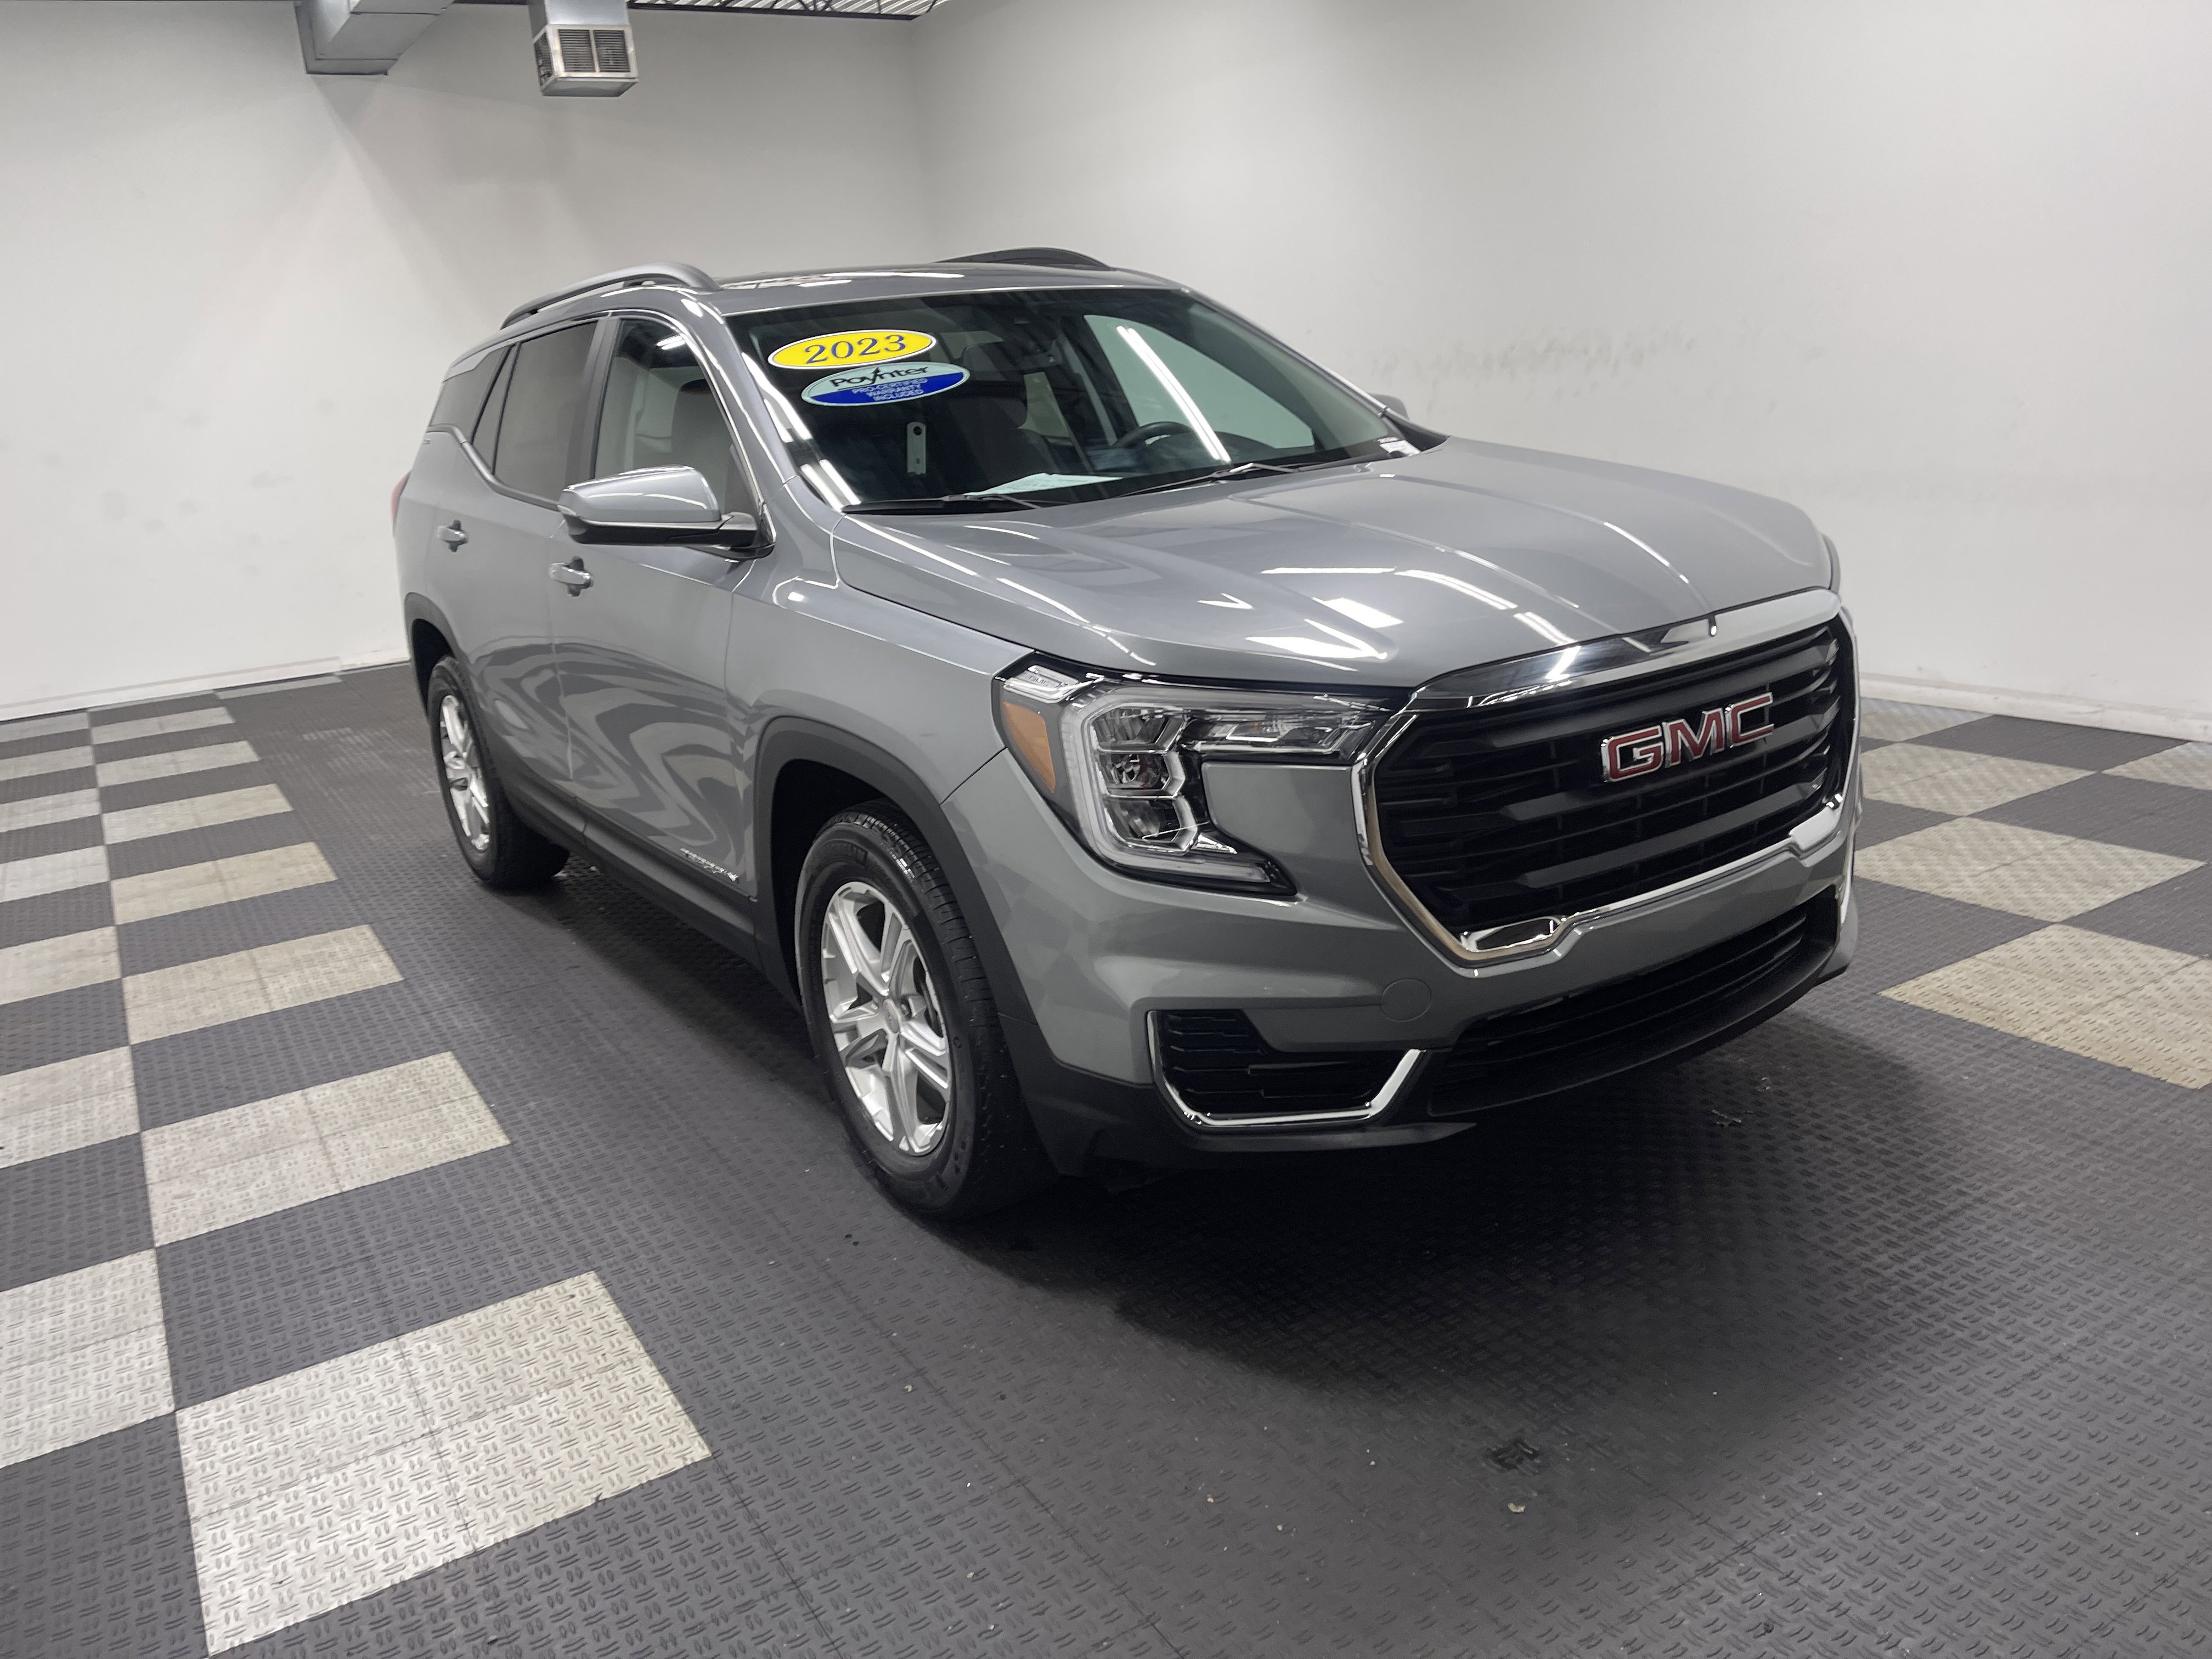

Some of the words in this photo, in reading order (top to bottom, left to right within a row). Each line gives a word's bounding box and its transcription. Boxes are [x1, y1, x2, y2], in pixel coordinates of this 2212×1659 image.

[804, 334, 906, 364] 2023
[829, 366, 928, 388] Poynter
[1600, 691, 1775, 783] GMC
